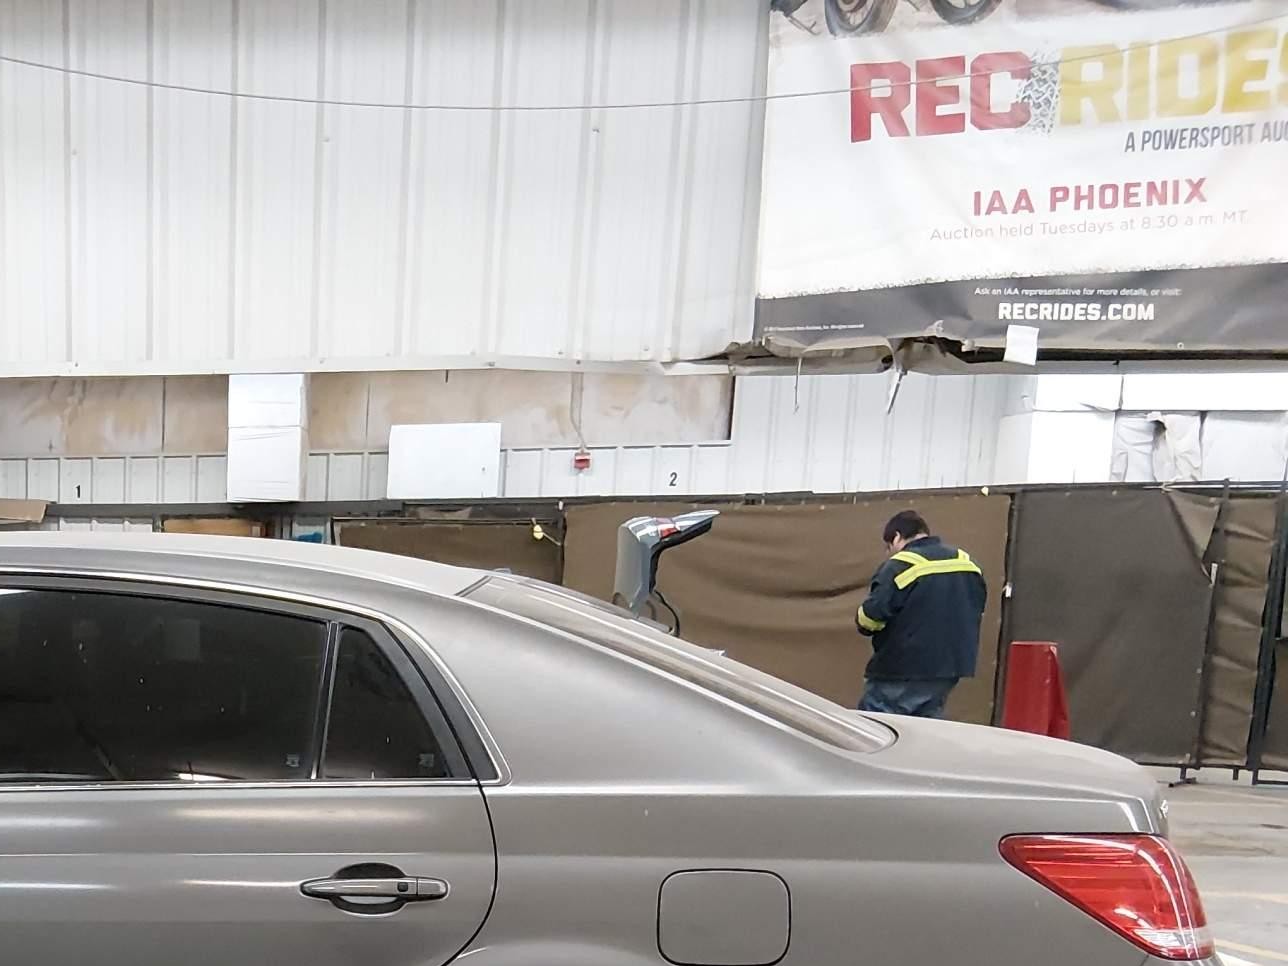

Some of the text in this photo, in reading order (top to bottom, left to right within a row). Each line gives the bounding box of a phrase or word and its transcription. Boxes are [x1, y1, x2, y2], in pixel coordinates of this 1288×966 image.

[850, 28, 1288, 143] REC RIDE
[1124, 131, 1136, 152] A
[1141, 123, 1255, 152] POWERSPORT
[973, 177, 1208, 216] IAA PHOENIX
[930, 225, 994, 241] Auction
[999, 223, 1034, 238] held
[1040, 219, 1115, 235] Tuesdays
[1120, 218, 1135, 231] at
[974, 287, 991, 296] Ask
[1003, 287, 1020, 296] IAA
[1021, 287, 1081, 297] representative
[1082, 287, 1095, 296] for
[1096, 288, 1119, 296] more
[1150, 288, 1161, 296] or
[998, 302, 1155, 321] RECRIDES.COM
[669, 471, 678, 487] 2
[75, 484, 81, 499] 1
